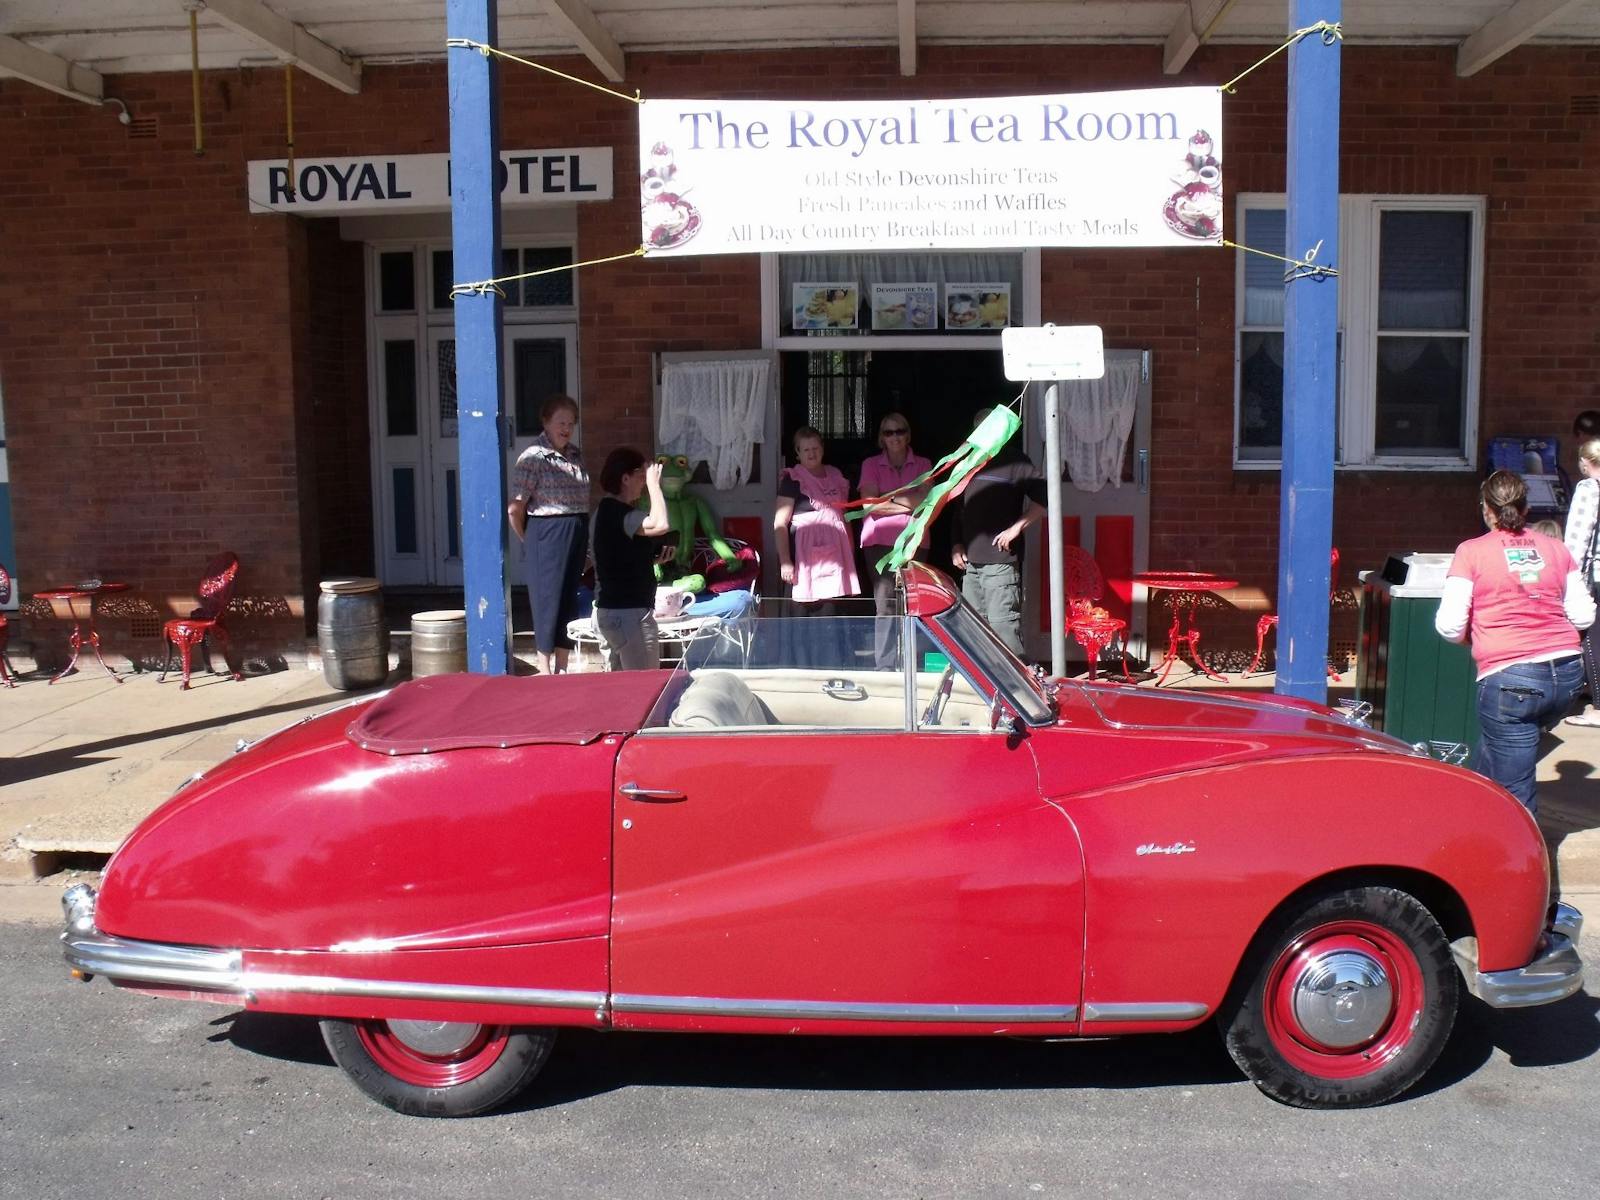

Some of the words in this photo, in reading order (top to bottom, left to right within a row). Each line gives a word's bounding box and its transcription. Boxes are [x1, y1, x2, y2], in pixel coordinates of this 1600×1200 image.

[679, 109, 770, 150] The
[786, 106, 921, 158] Royal
[934, 106, 1022, 143] Tea
[1040, 103, 1181, 142] Room
[268, 161, 412, 204] ROYAL
[805, 170, 839, 187] Old
[844, 169, 892, 190] Style
[897, 168, 1009, 187] Devonshire
[1013, 168, 1059, 184] Teas
[798, 197, 851, 214] Fresh
[857, 194, 946, 212] Pancakes
[952, 194, 988, 211] and
[995, 192, 1067, 210] Waffles
[726, 223, 752, 242] All
[760, 223, 797, 245] Day
[801, 222, 881, 243] Country
[887, 220, 976, 238] Breakfast
[982, 220, 1018, 237] and
[1024, 220, 1078, 239] Tasty
[1081, 218, 1140, 236] Meals
